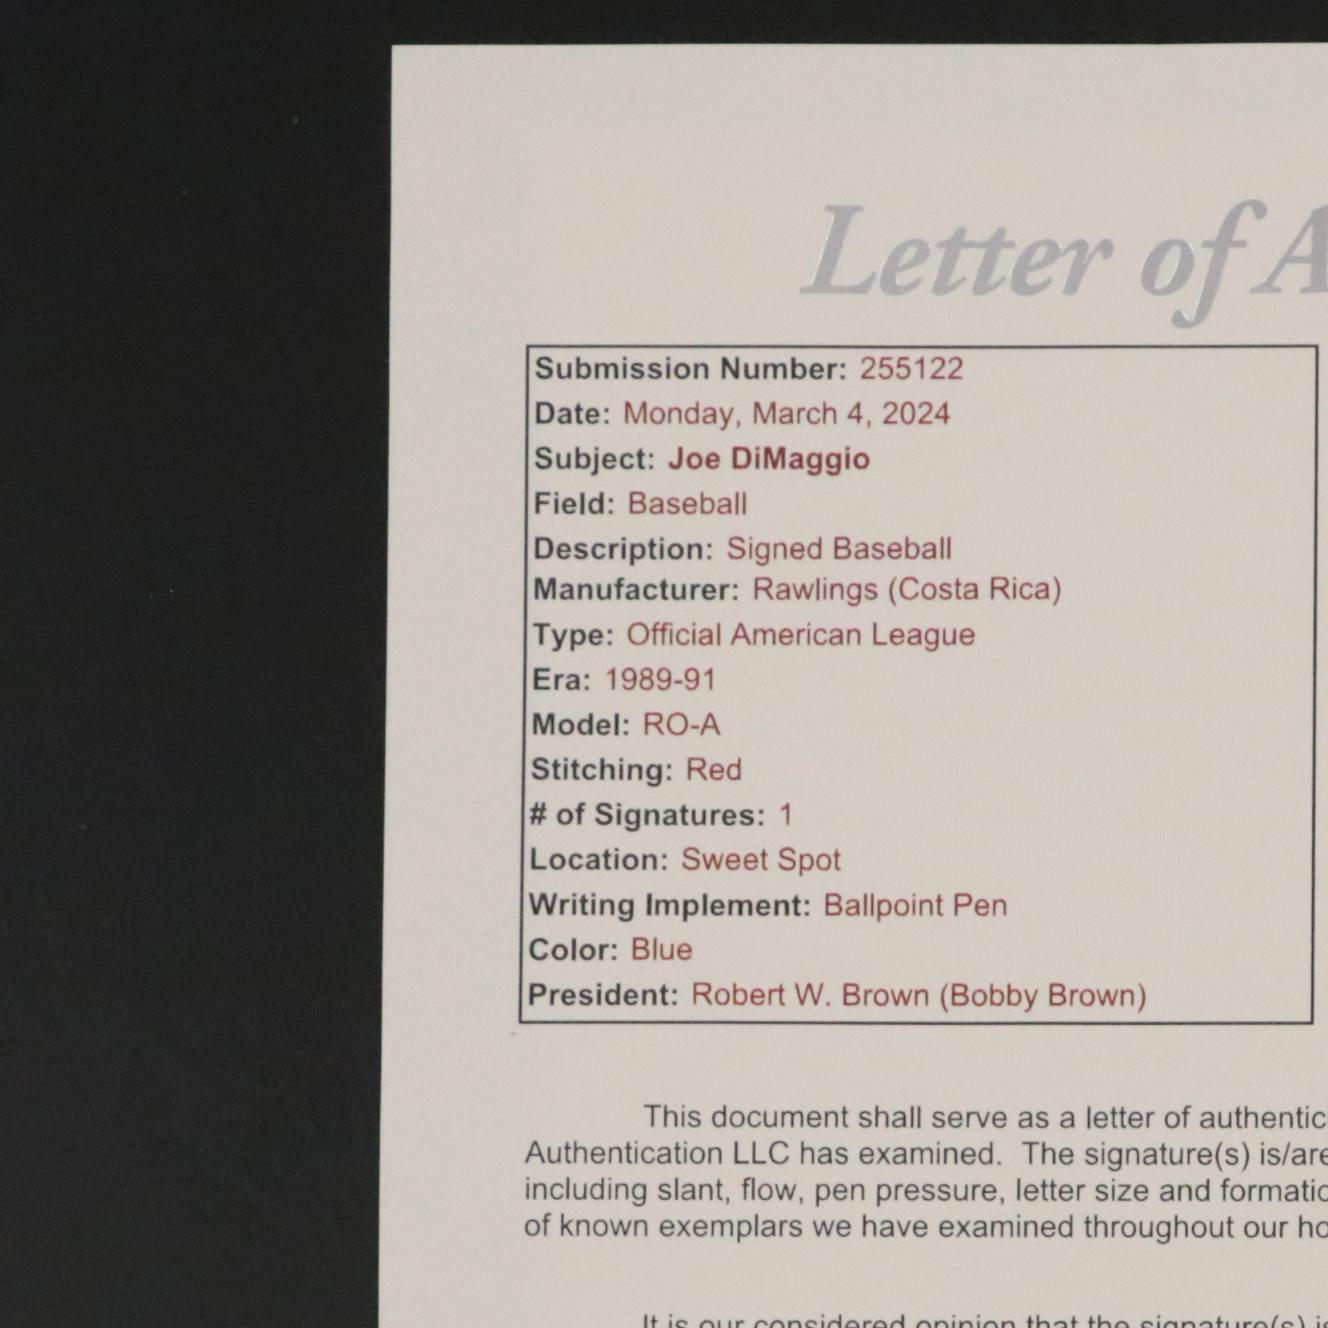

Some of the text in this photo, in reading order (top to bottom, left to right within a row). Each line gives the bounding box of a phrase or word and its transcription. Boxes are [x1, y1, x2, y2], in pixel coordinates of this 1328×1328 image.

[800, 202, 1115, 297] Letter
[1140, 199, 1268, 330] of
[535, 356, 963, 380] Submission Number: 255122
[535, 401, 950, 431] Date: Monday, March 4, 2024
[534, 446, 870, 476] Subject: Joe DiMaggio
[534, 536, 951, 566] Description: Signed Baseball
[534, 576, 1061, 607] Manufacturer: Rawlings (Costa Rica)
[533, 622, 975, 652] Type: Official American League
[533, 667, 713, 691] Era: 1989-91
[531, 757, 741, 787] Stitching: Red
[529, 802, 790, 832] # of Signatures: 1
[530, 847, 841, 877] Location: Sweet Spot
[528, 892, 1007, 922] Writing Implement: Ballpoint Pen
[529, 982, 1146, 1013] President: Robert W. Brown (Bobby Brown)
[525, 1212, 552, 1236] of
[560, 1213, 648, 1237] known
[659, 1213, 802, 1243] exemplars
[813, 1219, 851, 1238] we
[862, 1214, 928, 1238] have
[939, 1214, 1073, 1238] examined
[1084, 1214, 1234, 1245] throughout
[1244, 1221, 1288, 1238] our
